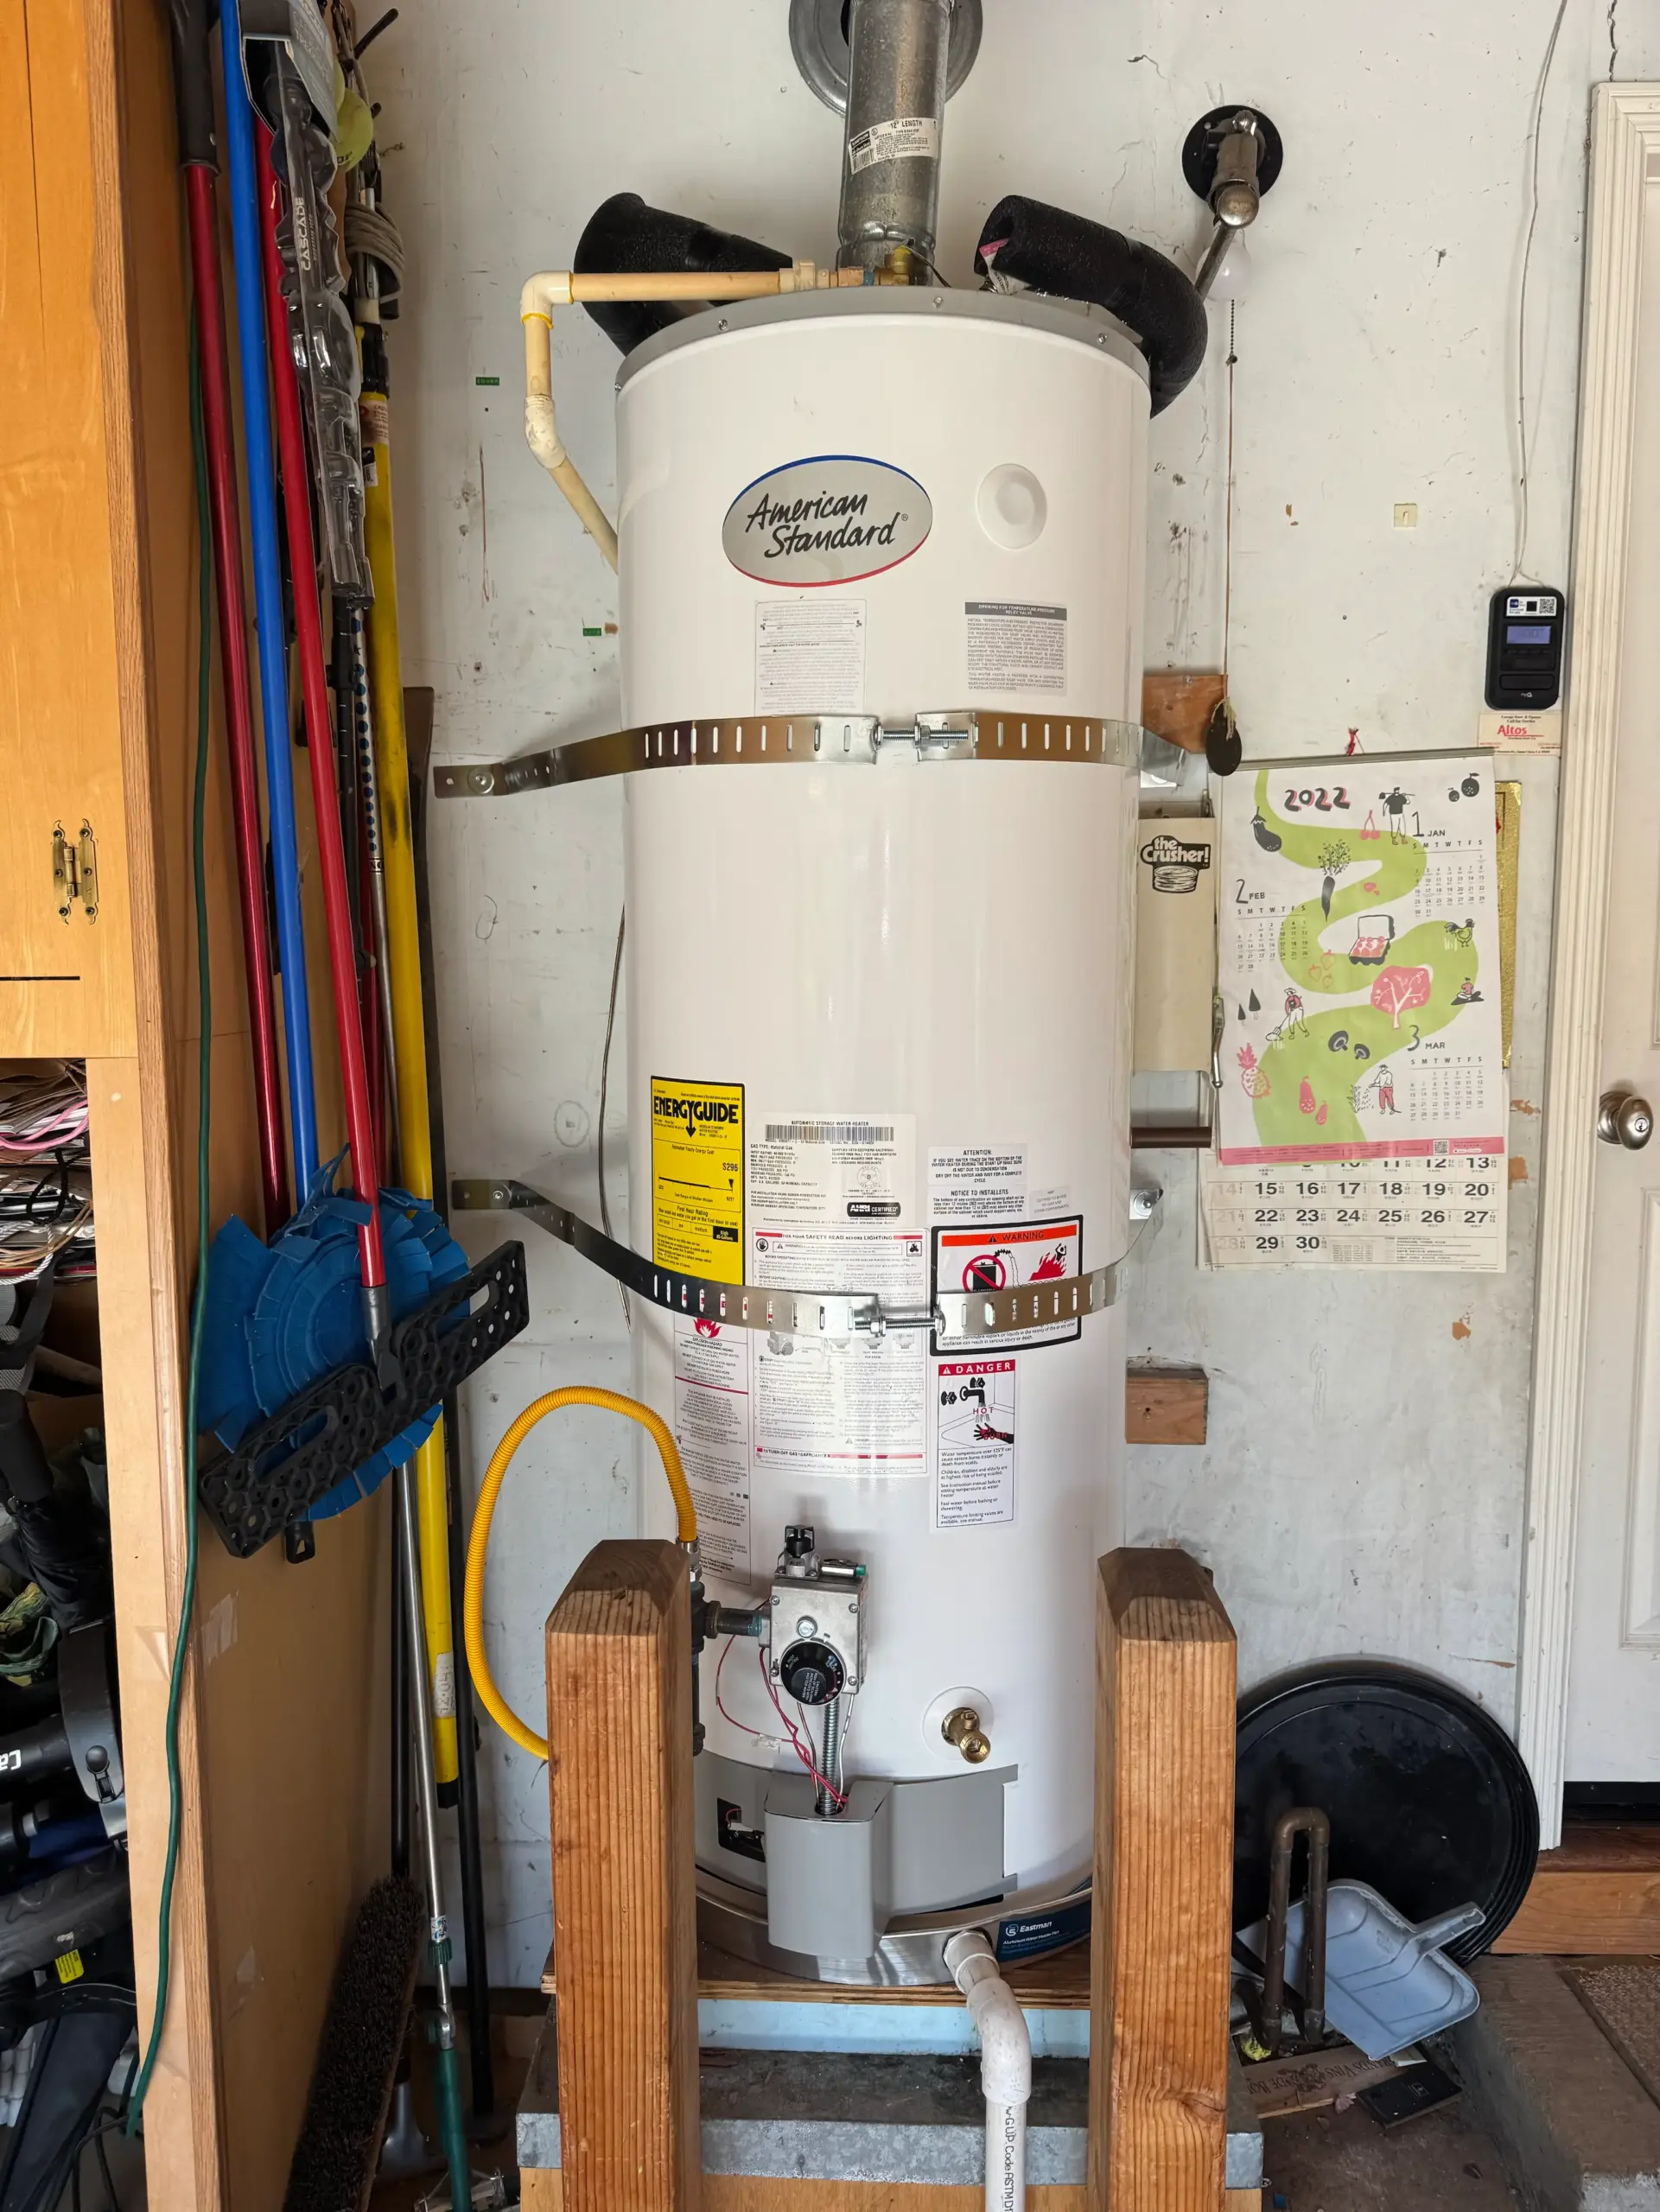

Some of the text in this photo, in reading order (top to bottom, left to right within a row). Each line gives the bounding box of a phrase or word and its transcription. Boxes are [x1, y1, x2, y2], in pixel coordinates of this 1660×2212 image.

[296, 197, 311, 271] CASCADE
[745, 491, 868, 533] American
[764, 512, 900, 558] Standard
[1497, 725, 1527, 734] Altos
[1284, 786, 1351, 812] 2022
[1412, 811, 1424, 837] 1
[1154, 836, 1178, 851] the
[1142, 848, 1209, 863] Crusher!
[1236, 879, 1249, 904] 2
[1407, 1025, 1420, 1052] 3
[653, 1096, 739, 1124] ENERGYGUIDE
[722, 1162, 738, 1172] $296
[1466, 1157, 1490, 1168] 13
[1255, 1183, 1277, 1195] 15
[1296, 1183, 1319, 1195] 16
[1338, 1183, 1360, 1195] 17
[1379, 1183, 1402, 1195] 18
[1422, 1183, 1446, 1196] 19
[1465, 1184, 1489, 1196] 20
[1255, 1210, 1278, 1222] 22
[1296, 1210, 1319, 1222] 23
[1337, 1210, 1360, 1223] 24
[1378, 1210, 1402, 1223] 25
[1421, 1210, 1445, 1223] 26
[1464, 1211, 1489, 1224] 27
[1002, 1231, 1044, 1242] WARNING
[1256, 1236, 1278, 1249] 29
[1296, 1236, 1320, 1249] 30
[956, 1363, 1010, 1374] DANGER
[983, 1432, 1008, 1440] BURN
[1020, 1922, 1053, 1933] Eastman
[1324, 2063, 1357, 2078] VINS
[1353, 2056, 1394, 2072] RANDS
[1005, 2145, 1014, 2171] Code
[1005, 2172, 1014, 2199] ASTM
